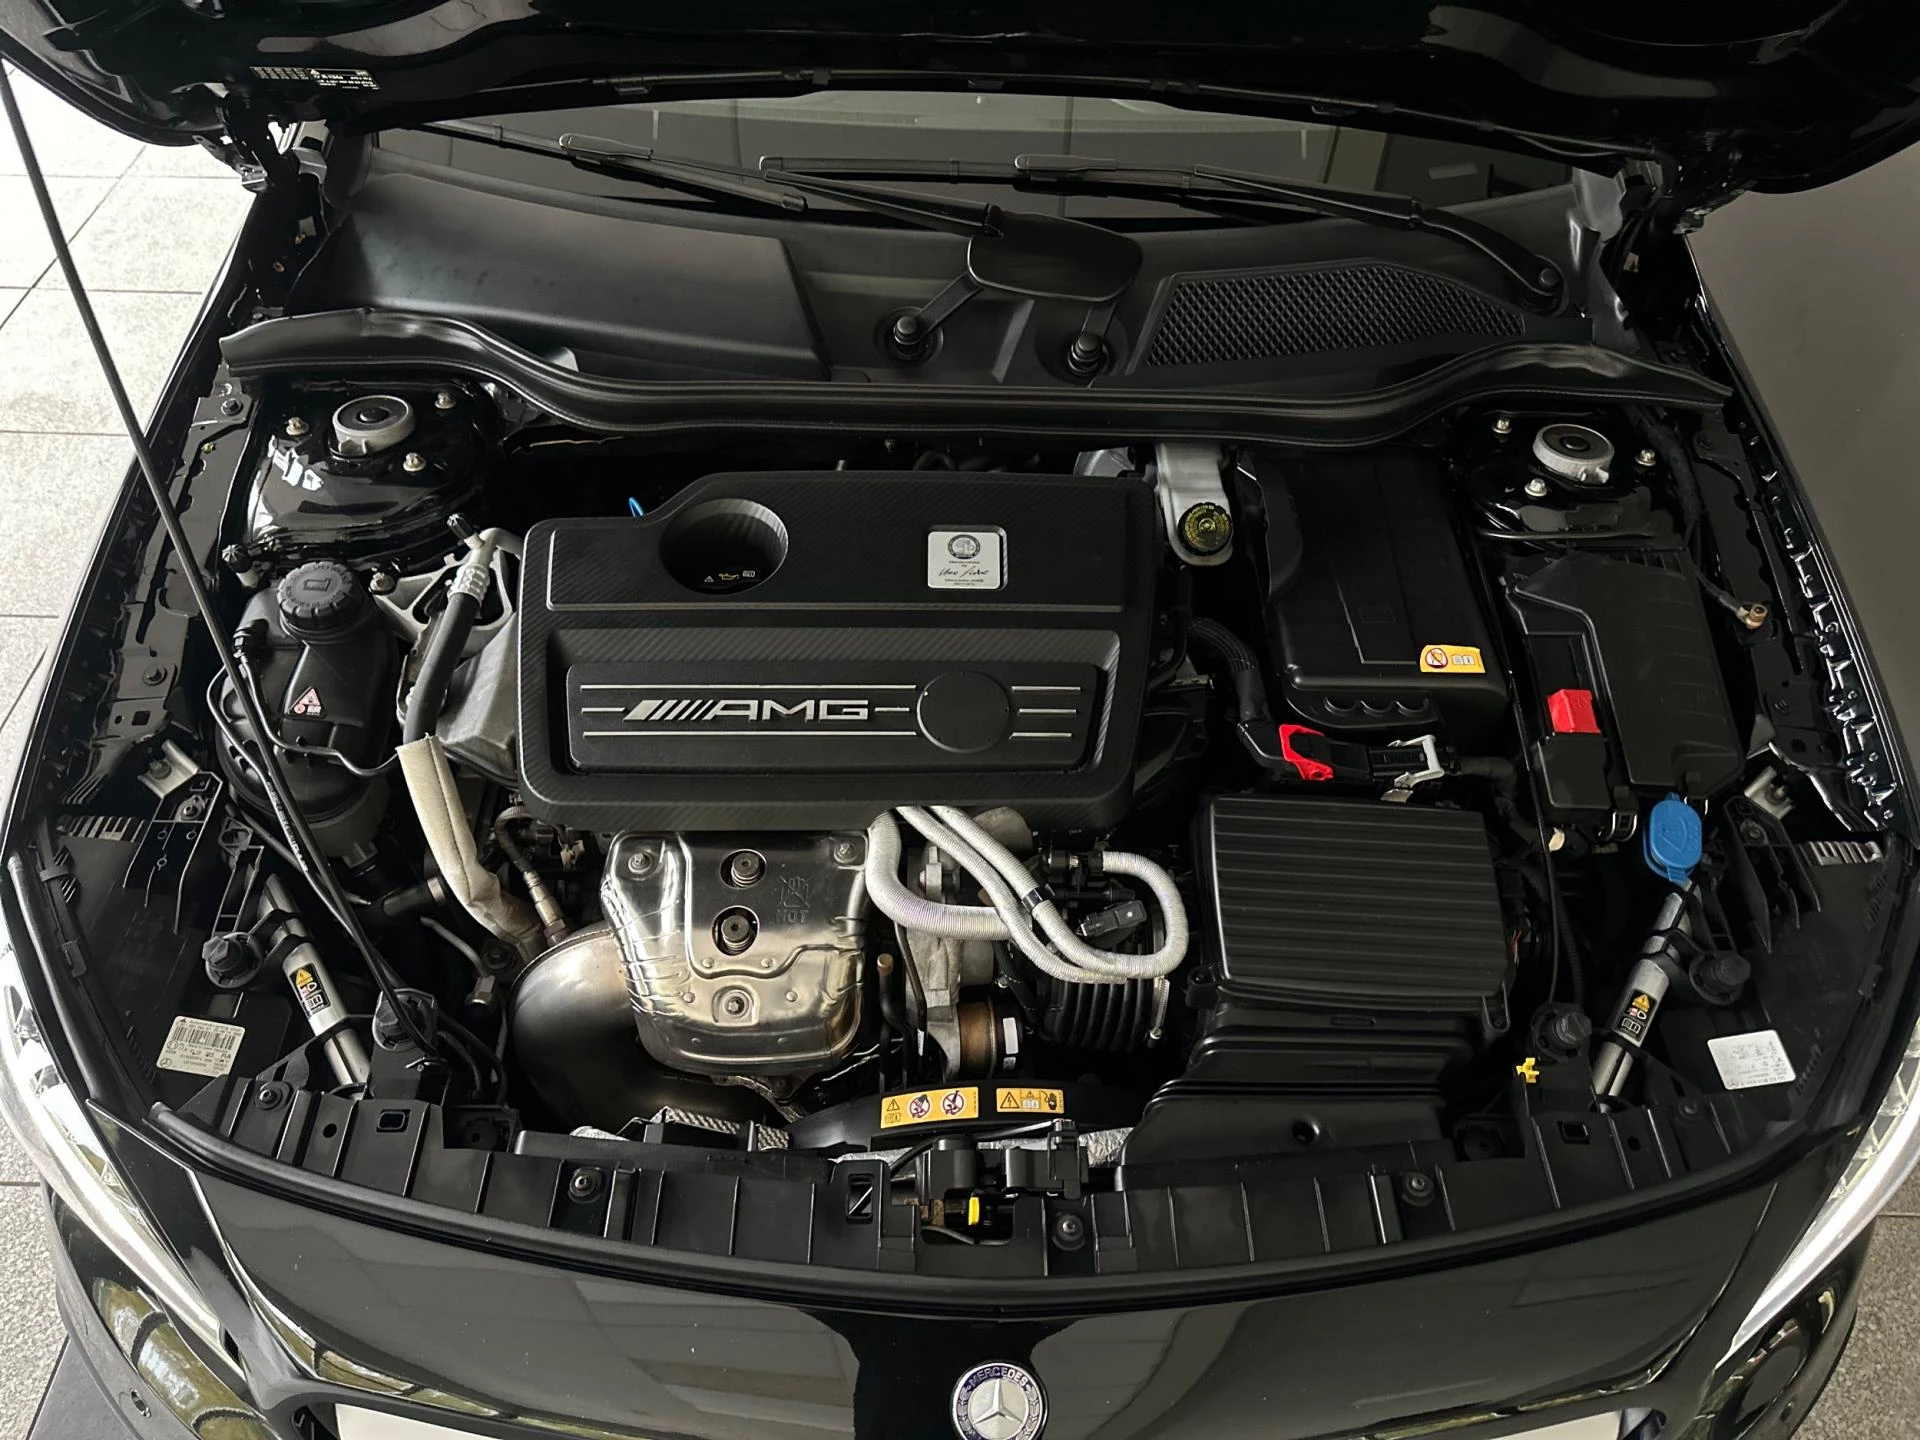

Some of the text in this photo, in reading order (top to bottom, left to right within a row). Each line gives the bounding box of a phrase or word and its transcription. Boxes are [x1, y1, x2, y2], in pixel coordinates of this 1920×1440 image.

[703, 699, 870, 723] AMG
[775, 909, 808, 923] HOT
[969, 1366, 1028, 1387] MERCEDES
